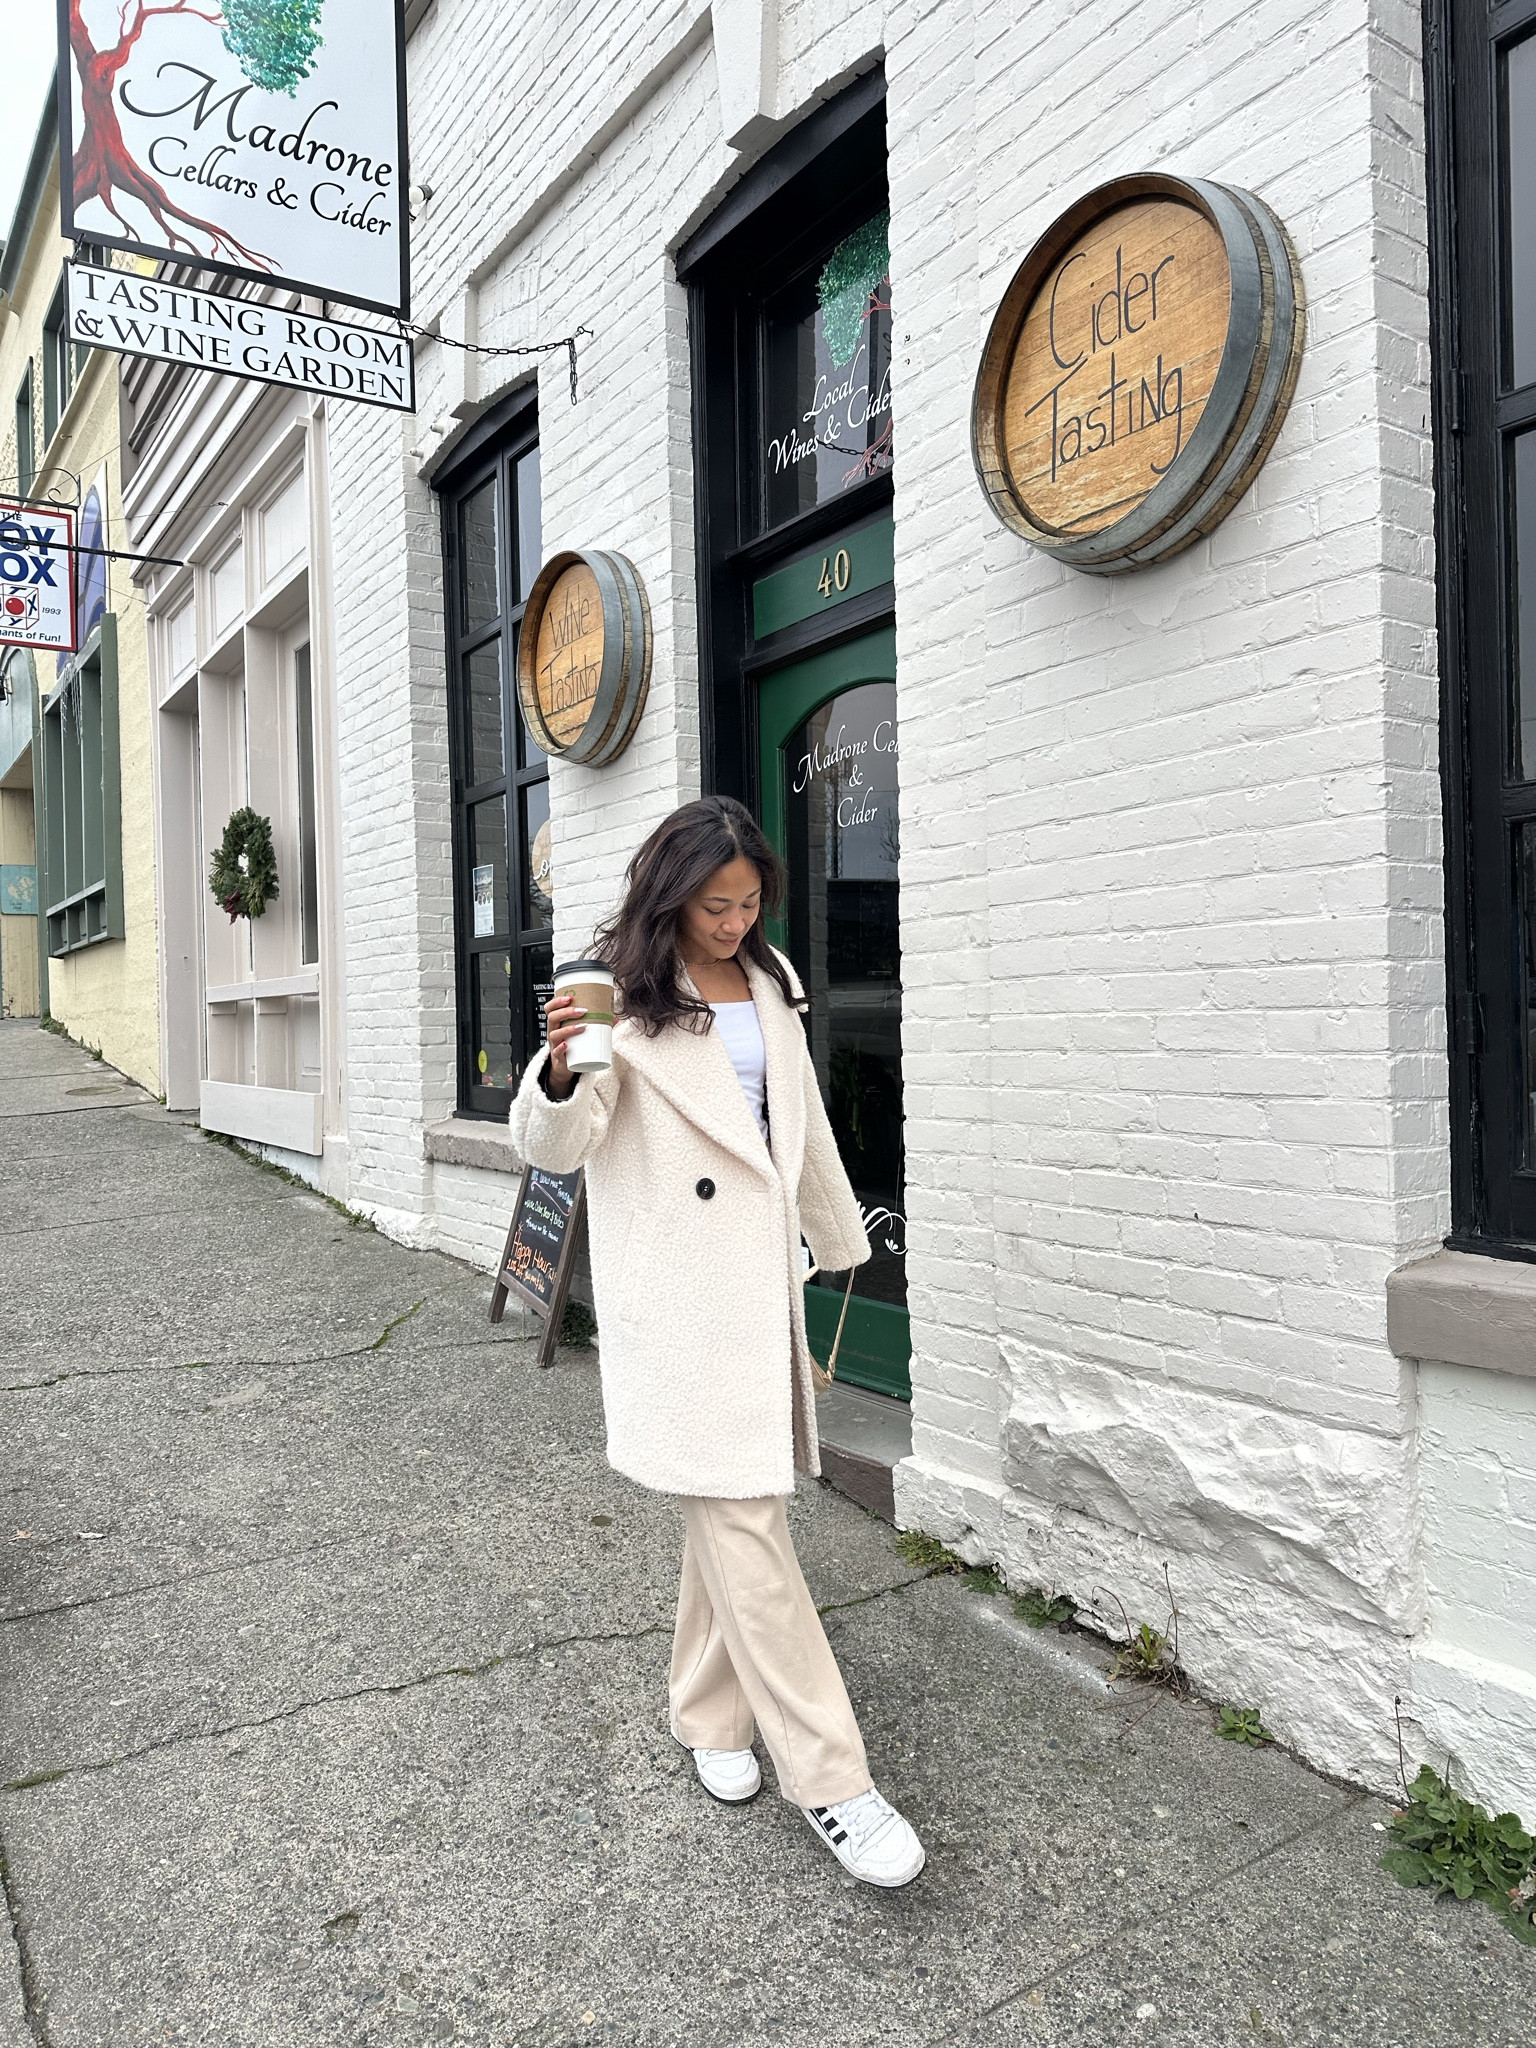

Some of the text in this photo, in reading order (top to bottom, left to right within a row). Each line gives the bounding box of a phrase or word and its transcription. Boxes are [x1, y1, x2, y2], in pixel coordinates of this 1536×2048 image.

[119, 62, 392, 187] Madrone
[148, 136, 392, 236] Cellars & Cider
[76, 270, 404, 369] TASTING ROOM
[1050, 244, 1174, 369] Cider
[74, 308, 404, 401] & WINE GARDEN
[803, 344, 865, 422] Local
[768, 429, 819, 474] Wines
[824, 415, 841, 444] &
[1, 511, 22, 521] THE
[817, 549, 850, 597] 40
[39, 633, 61, 642] Fun!
[42, 607, 62, 615] 1993
[793, 724, 868, 793] Madrone
[849, 764, 864, 787] &
[837, 787, 878, 827] Cider
[511, 1231, 532, 1269] Happy
[532, 1249, 551, 1273] Hour
